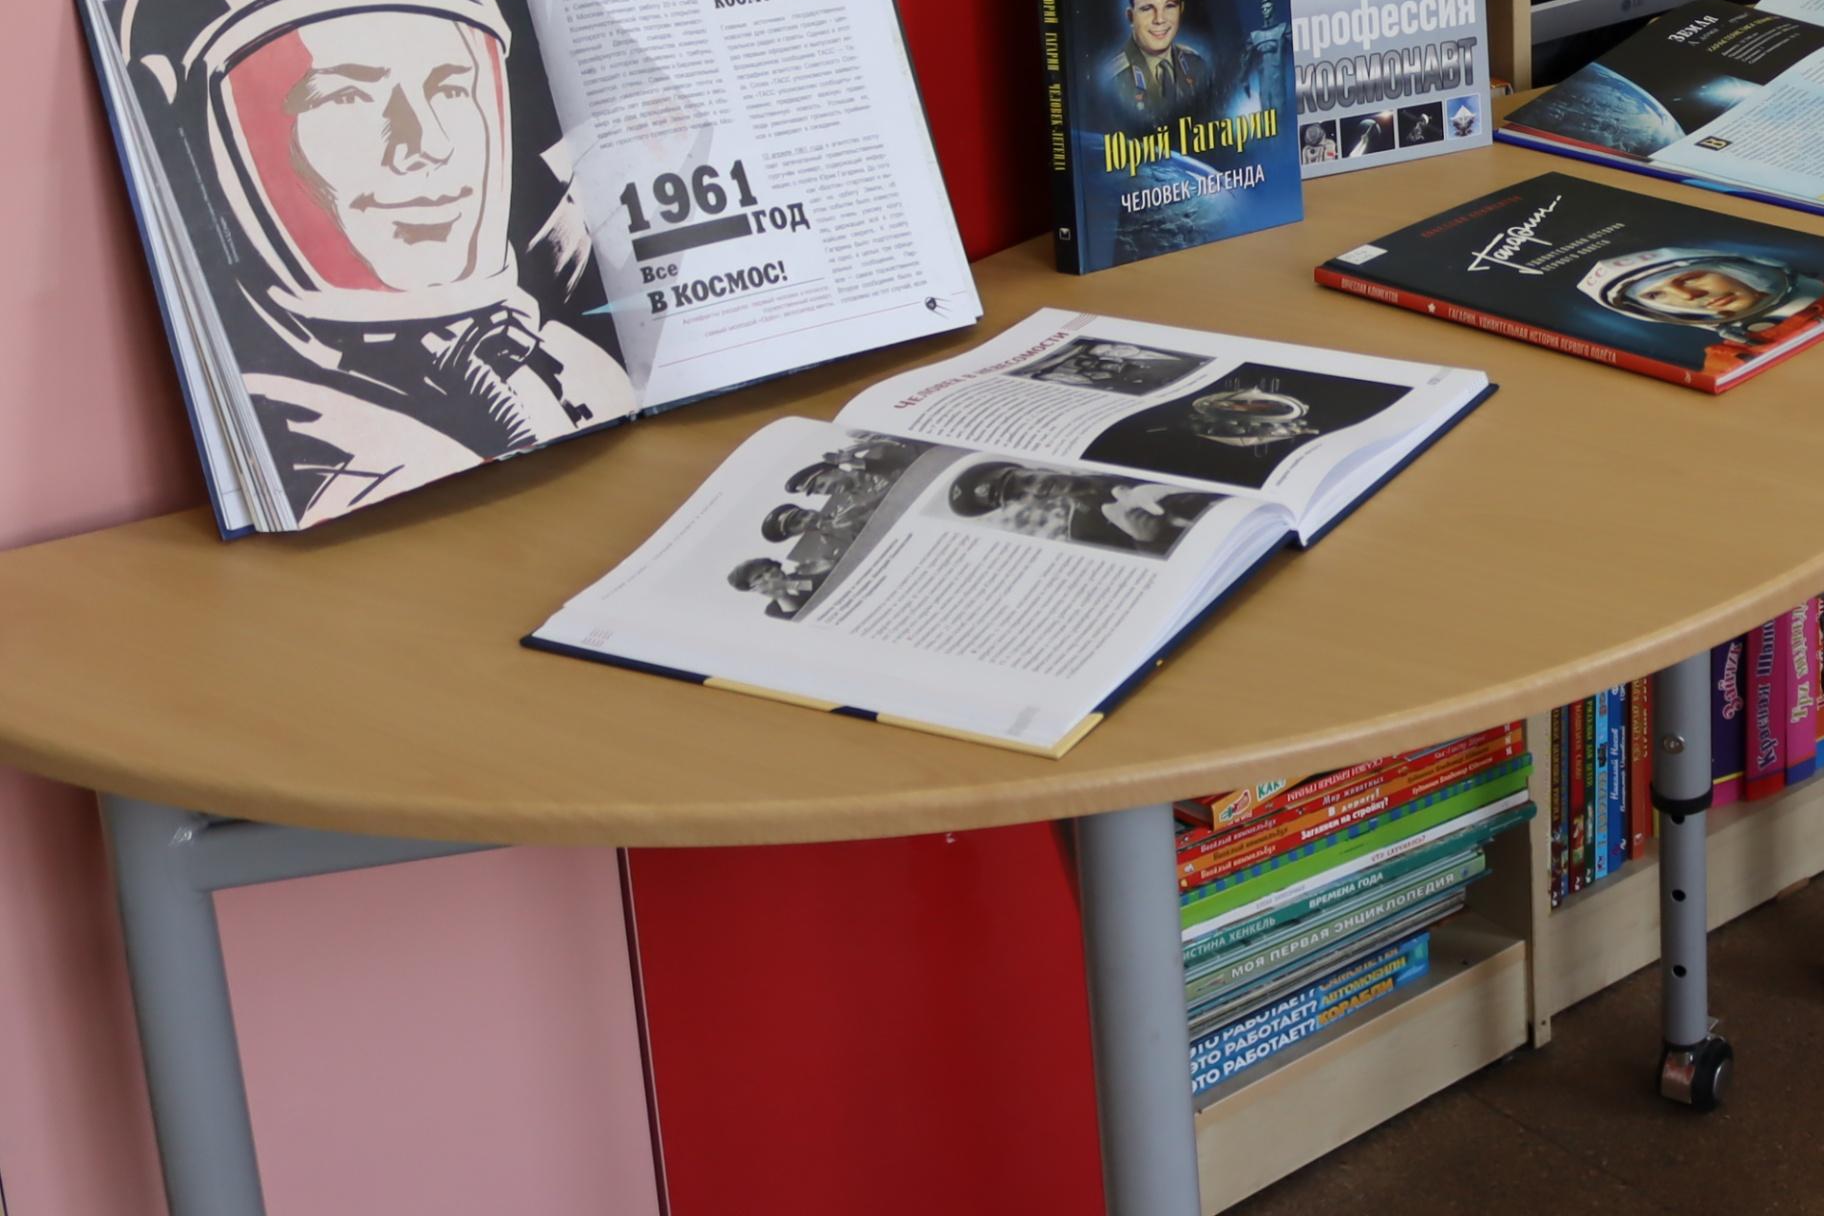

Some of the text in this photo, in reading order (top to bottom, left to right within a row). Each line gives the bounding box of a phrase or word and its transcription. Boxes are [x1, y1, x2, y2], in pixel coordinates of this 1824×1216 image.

[1295, 36, 1477, 115] КОСМОНАВТ
[1104, 108, 1278, 177] Юрий Гагарин
[619, 159, 758, 234] 1961
[1121, 164, 1265, 214] ЧЕЛОВЕК-ЛЕГЕНДА
[640, 262, 679, 284] Все
[671, 260, 788, 308] КОСМОС!
[1757, 684, 1779, 770] Красная
[1229, 915, 1276, 942] ХЕНКЕЛЬ
[1309, 883, 1356, 909] ВРЕМЕНА
[1357, 871, 1384, 891] ГОДА
[1231, 872, 1455, 979] МОЯ ПЕРВАЯ ЭНЦИКЛОПЕДИЯ
[1223, 1020, 1317, 1076] РАБОТАЕТ?
[1318, 978, 1394, 1026] КОРАБЛИ
[1224, 1001, 1318, 1056] РАБОТАЕТ?
